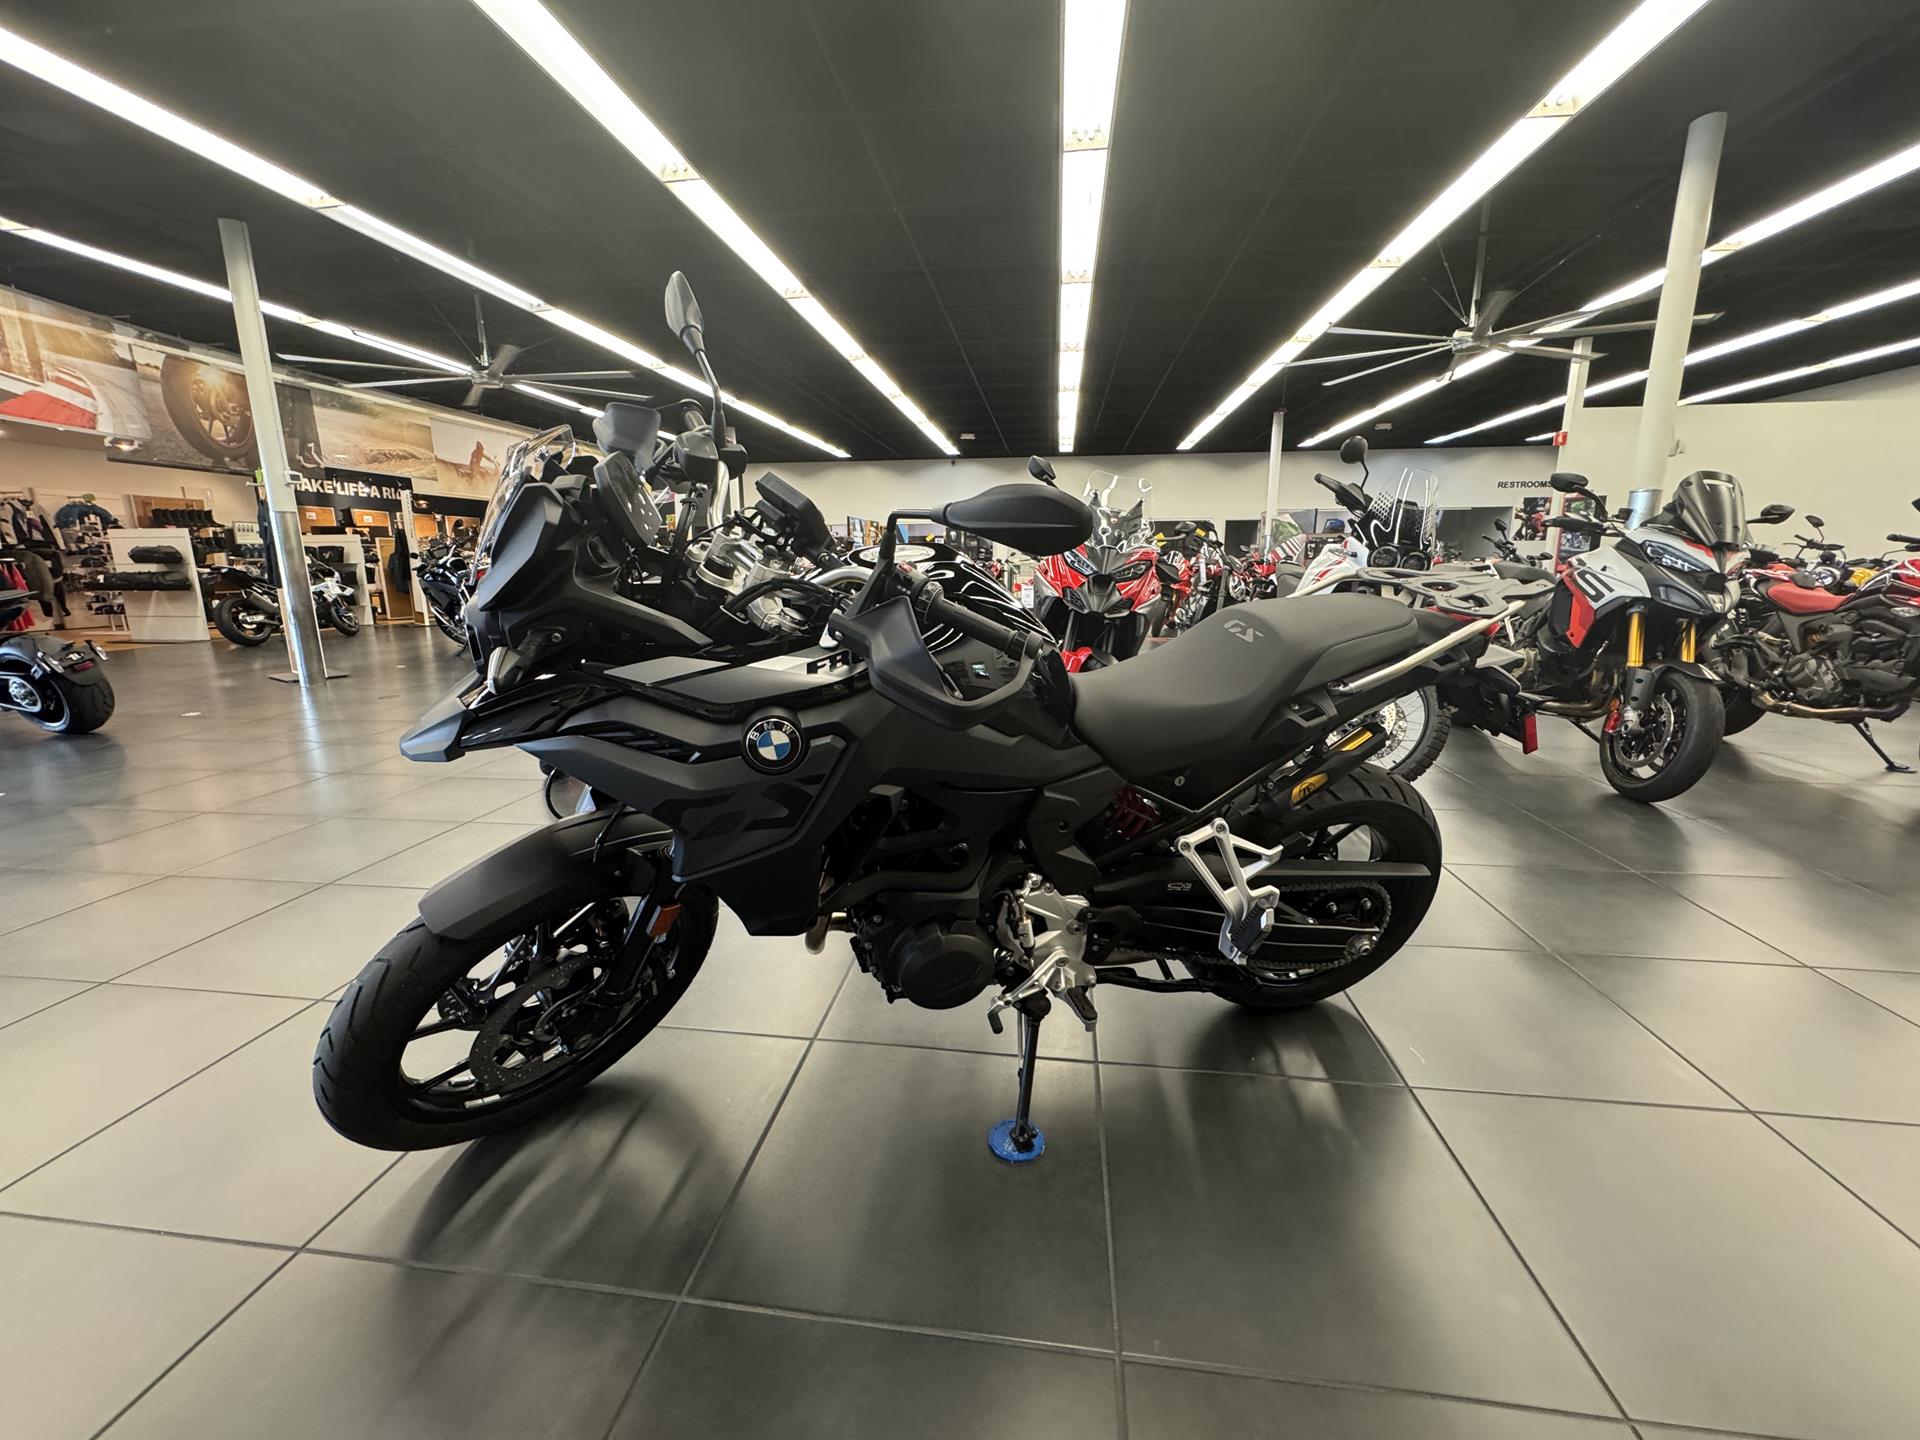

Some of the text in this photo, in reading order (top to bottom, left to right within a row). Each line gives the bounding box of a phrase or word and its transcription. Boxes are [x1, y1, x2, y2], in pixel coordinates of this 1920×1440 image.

[337, 481, 367, 497] LIFE
[370, 485, 381, 498] A
[1497, 480, 1553, 489] RESTROOMS
[749, 721, 794, 741] BMW
